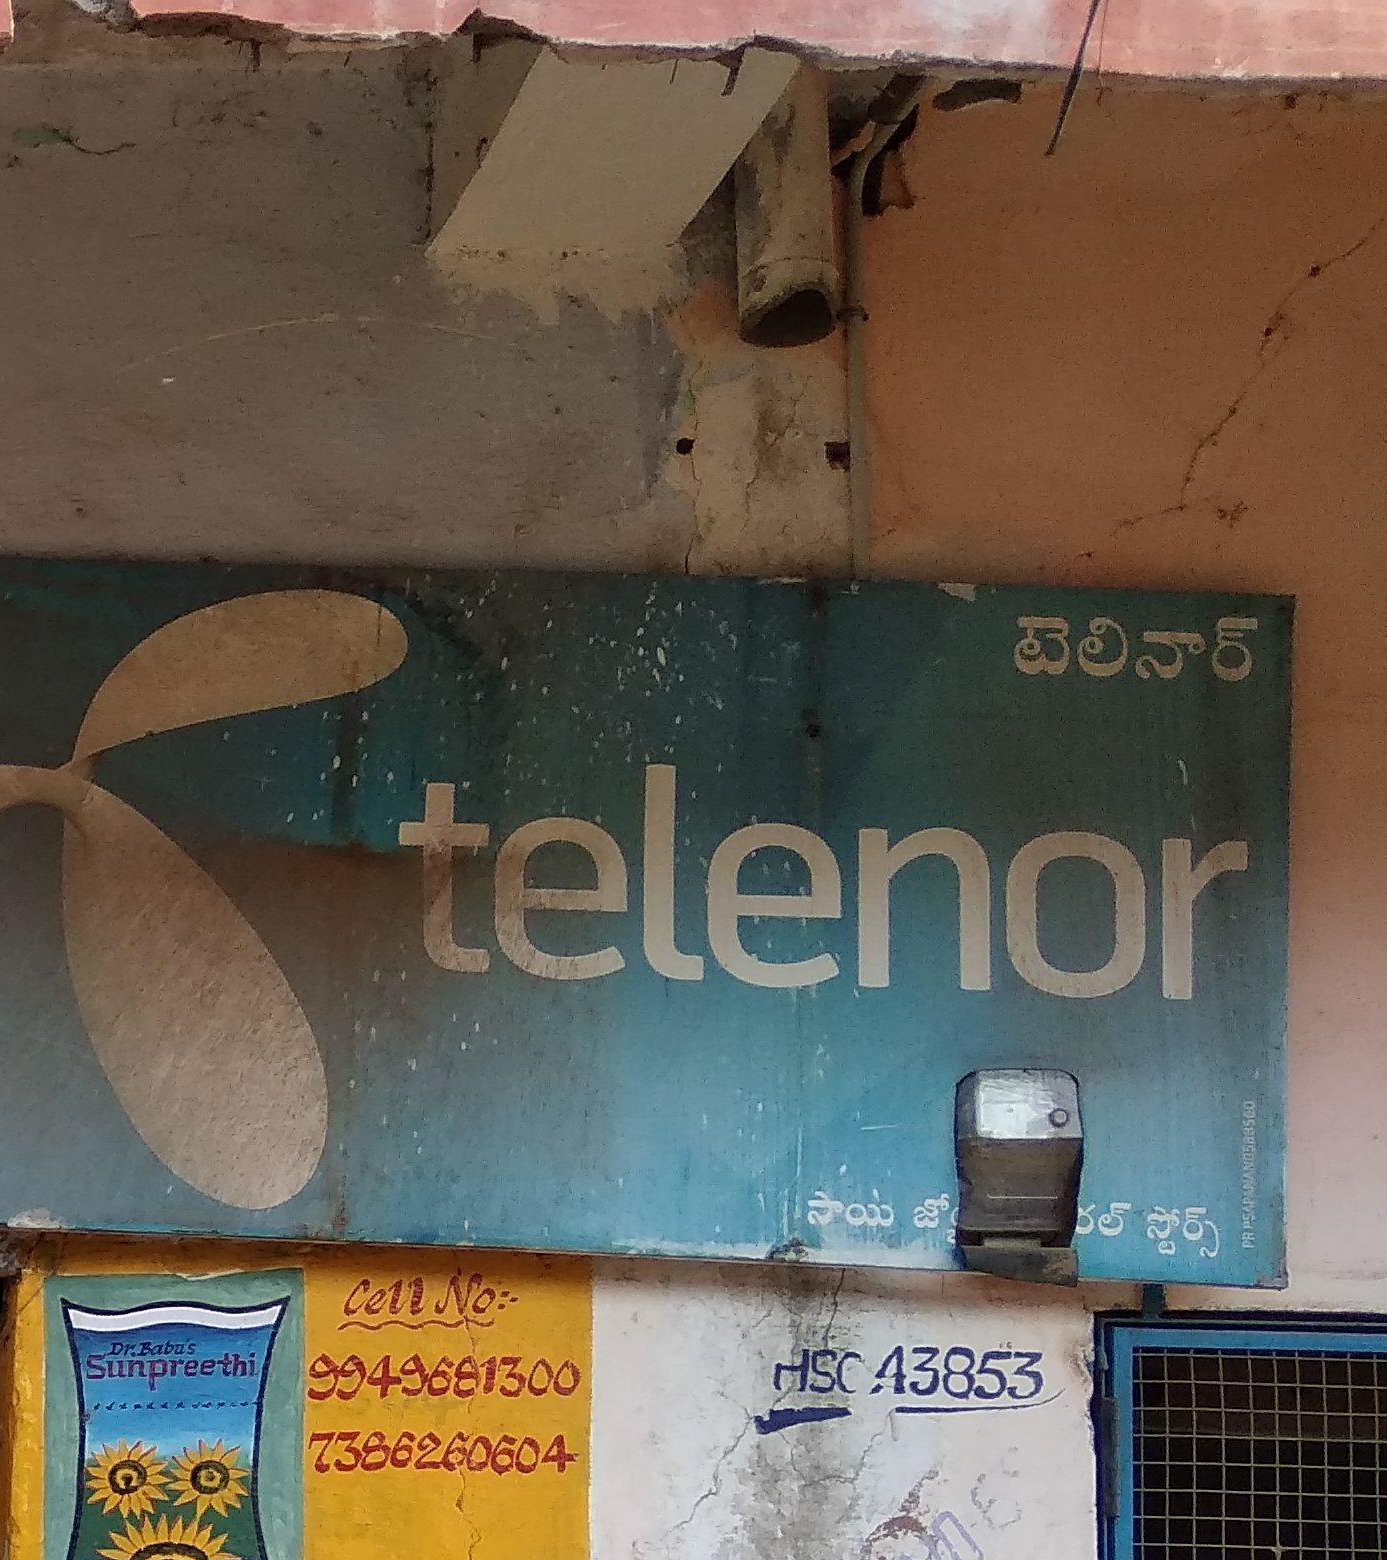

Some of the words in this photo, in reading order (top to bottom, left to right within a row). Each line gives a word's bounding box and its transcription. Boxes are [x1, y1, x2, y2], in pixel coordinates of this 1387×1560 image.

[1012, 614, 1256, 684] టెలినార్
[399, 763, 1251, 1000] telenor
[807, 1189, 895, 1228] సాయి
[342, 1279, 425, 1318] Cell
[85, 1352, 258, 1391] Sunpreethi
[306, 1352, 583, 1402] 9949681300
[773, 1348, 865, 1394] HSC
